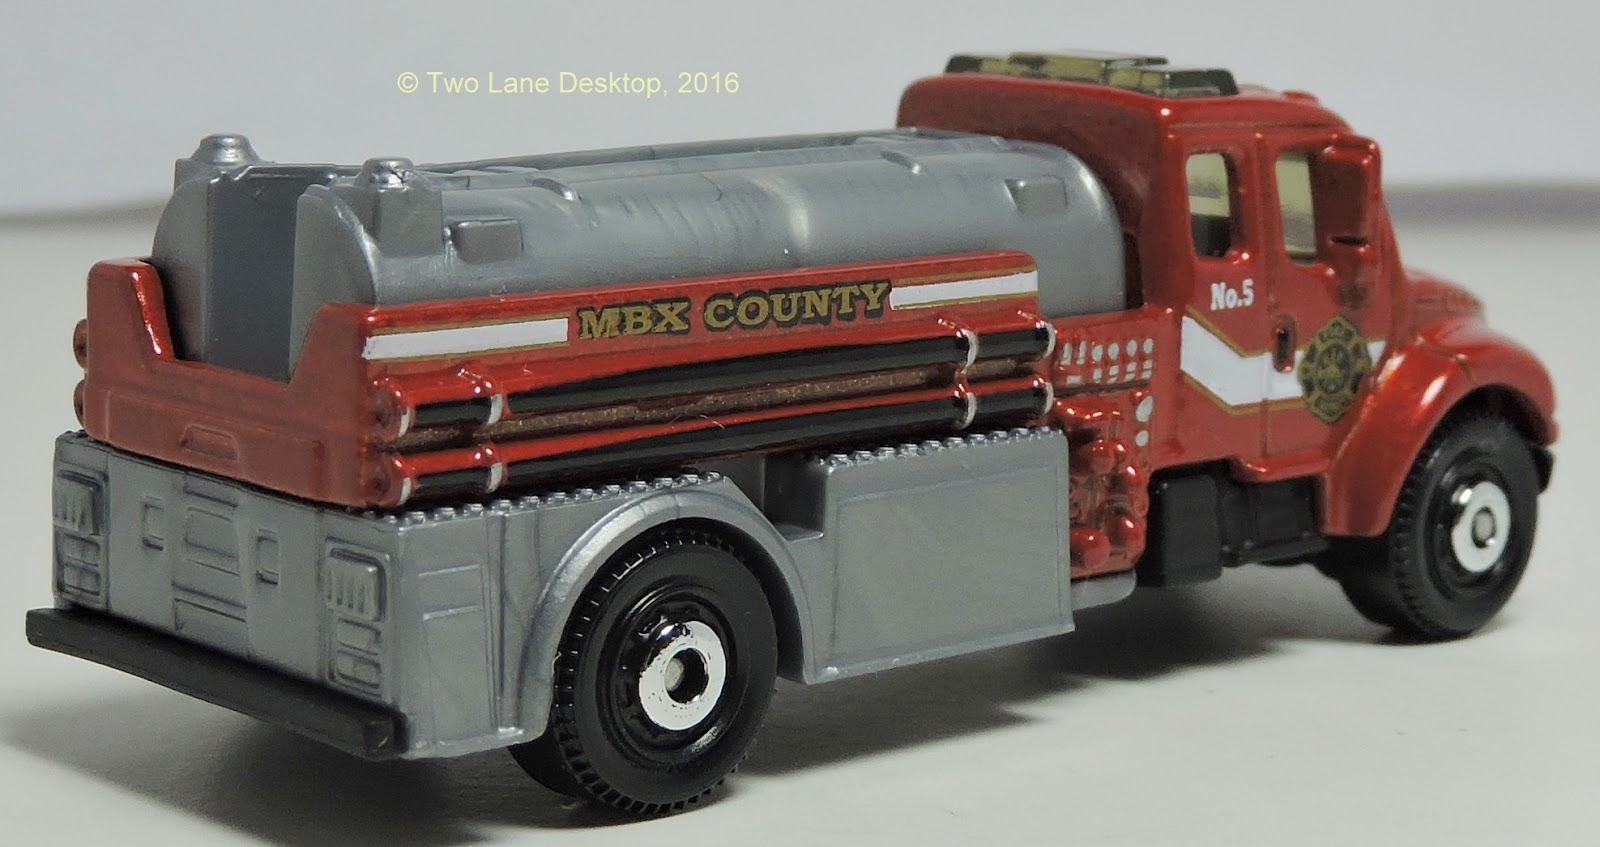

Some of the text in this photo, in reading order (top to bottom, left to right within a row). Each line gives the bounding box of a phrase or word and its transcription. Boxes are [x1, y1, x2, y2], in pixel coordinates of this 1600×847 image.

[578, 280, 892, 339] MBX COUNTY
[1210, 278, 1255, 311] No.5
